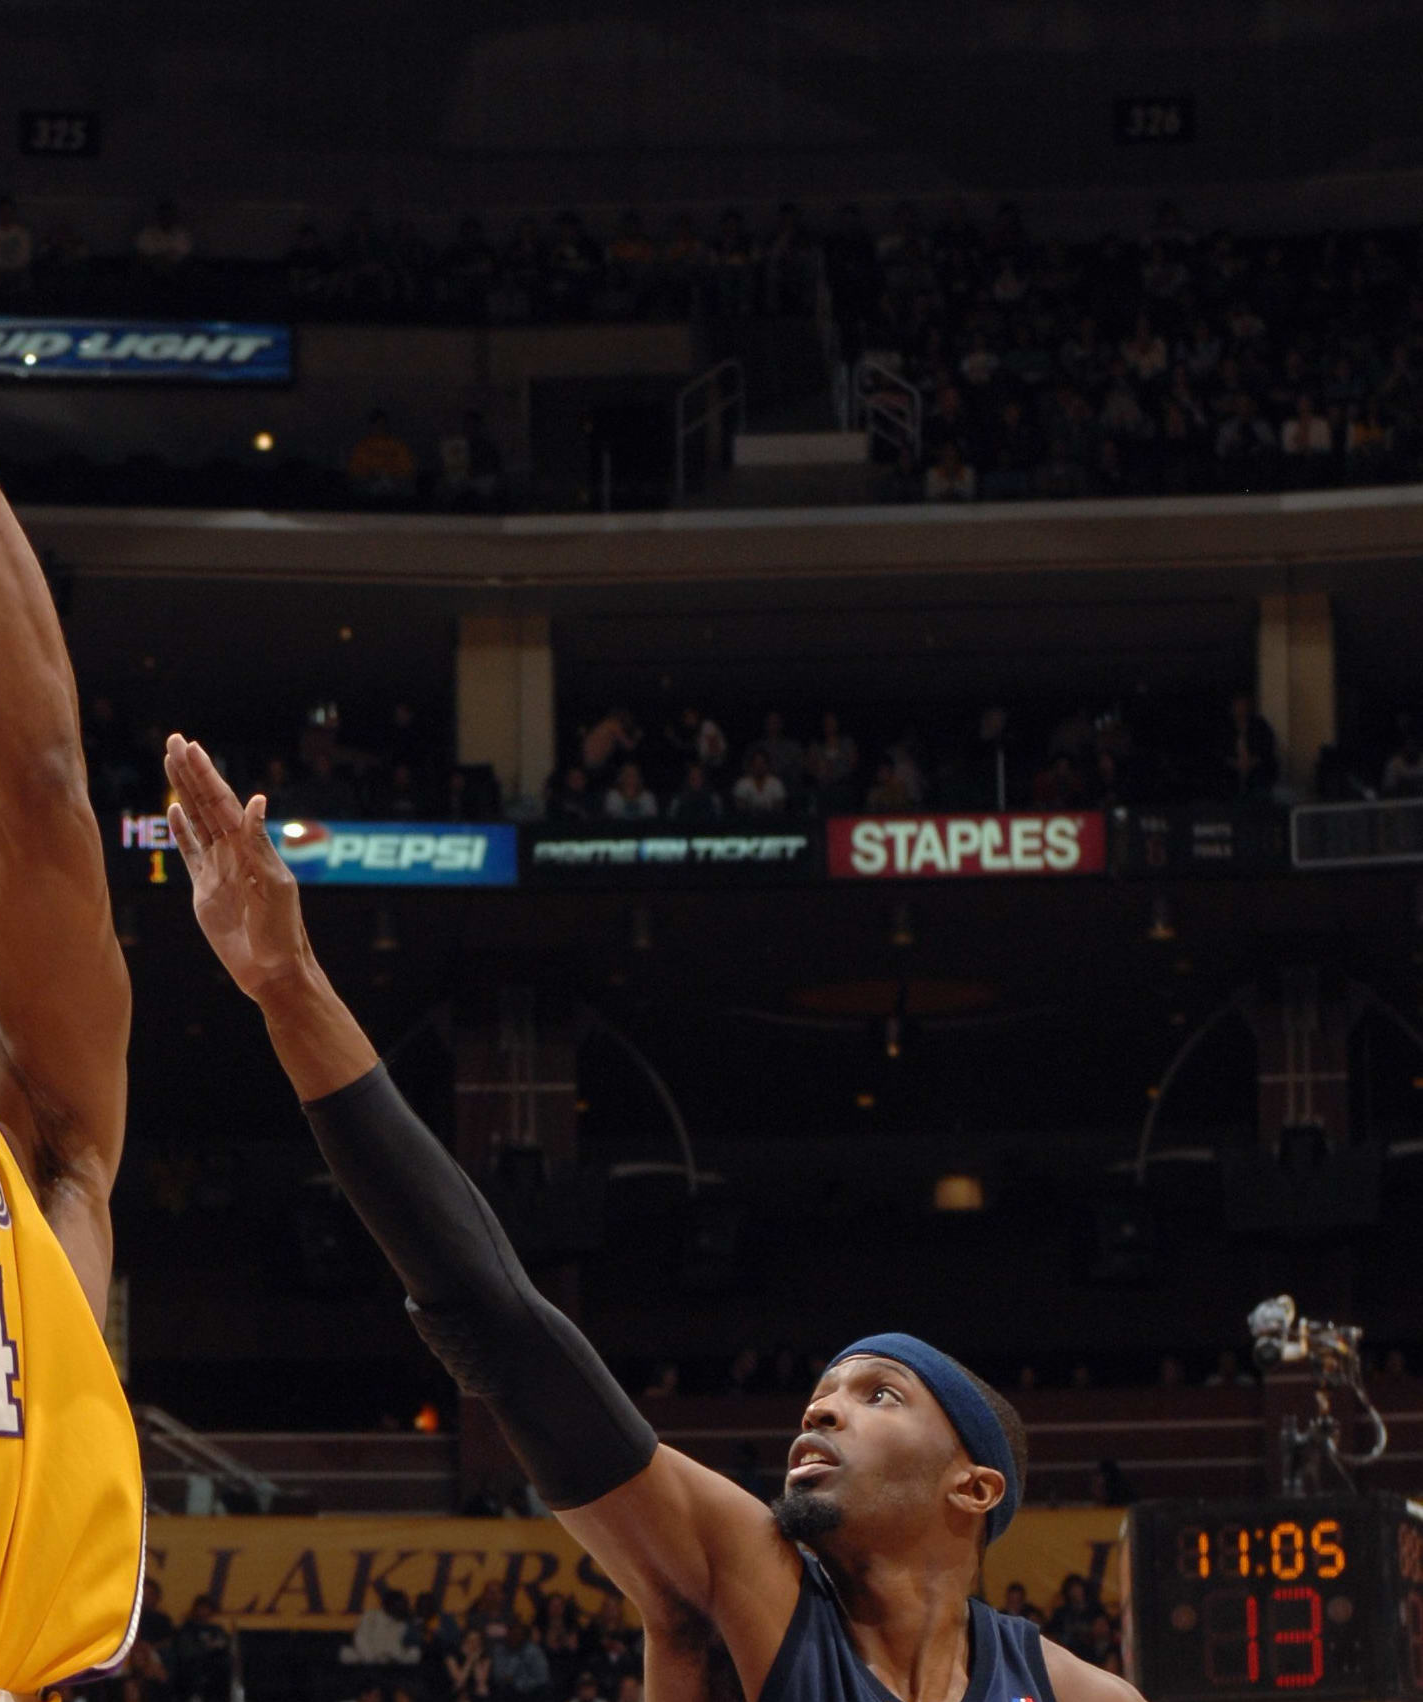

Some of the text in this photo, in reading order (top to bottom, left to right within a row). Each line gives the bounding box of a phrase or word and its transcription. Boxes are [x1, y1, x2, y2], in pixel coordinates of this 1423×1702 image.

[79, 333, 273, 362] LIGHT
[122, 815, 178, 849] ME
[691, 836, 807, 861] TICKET
[851, 816, 1080, 874] STAPLES
[327, 834, 488, 871] PEPSI
[1197, 1519, 1346, 1580] 11:05
[1246, 1586, 1324, 1688] 13
